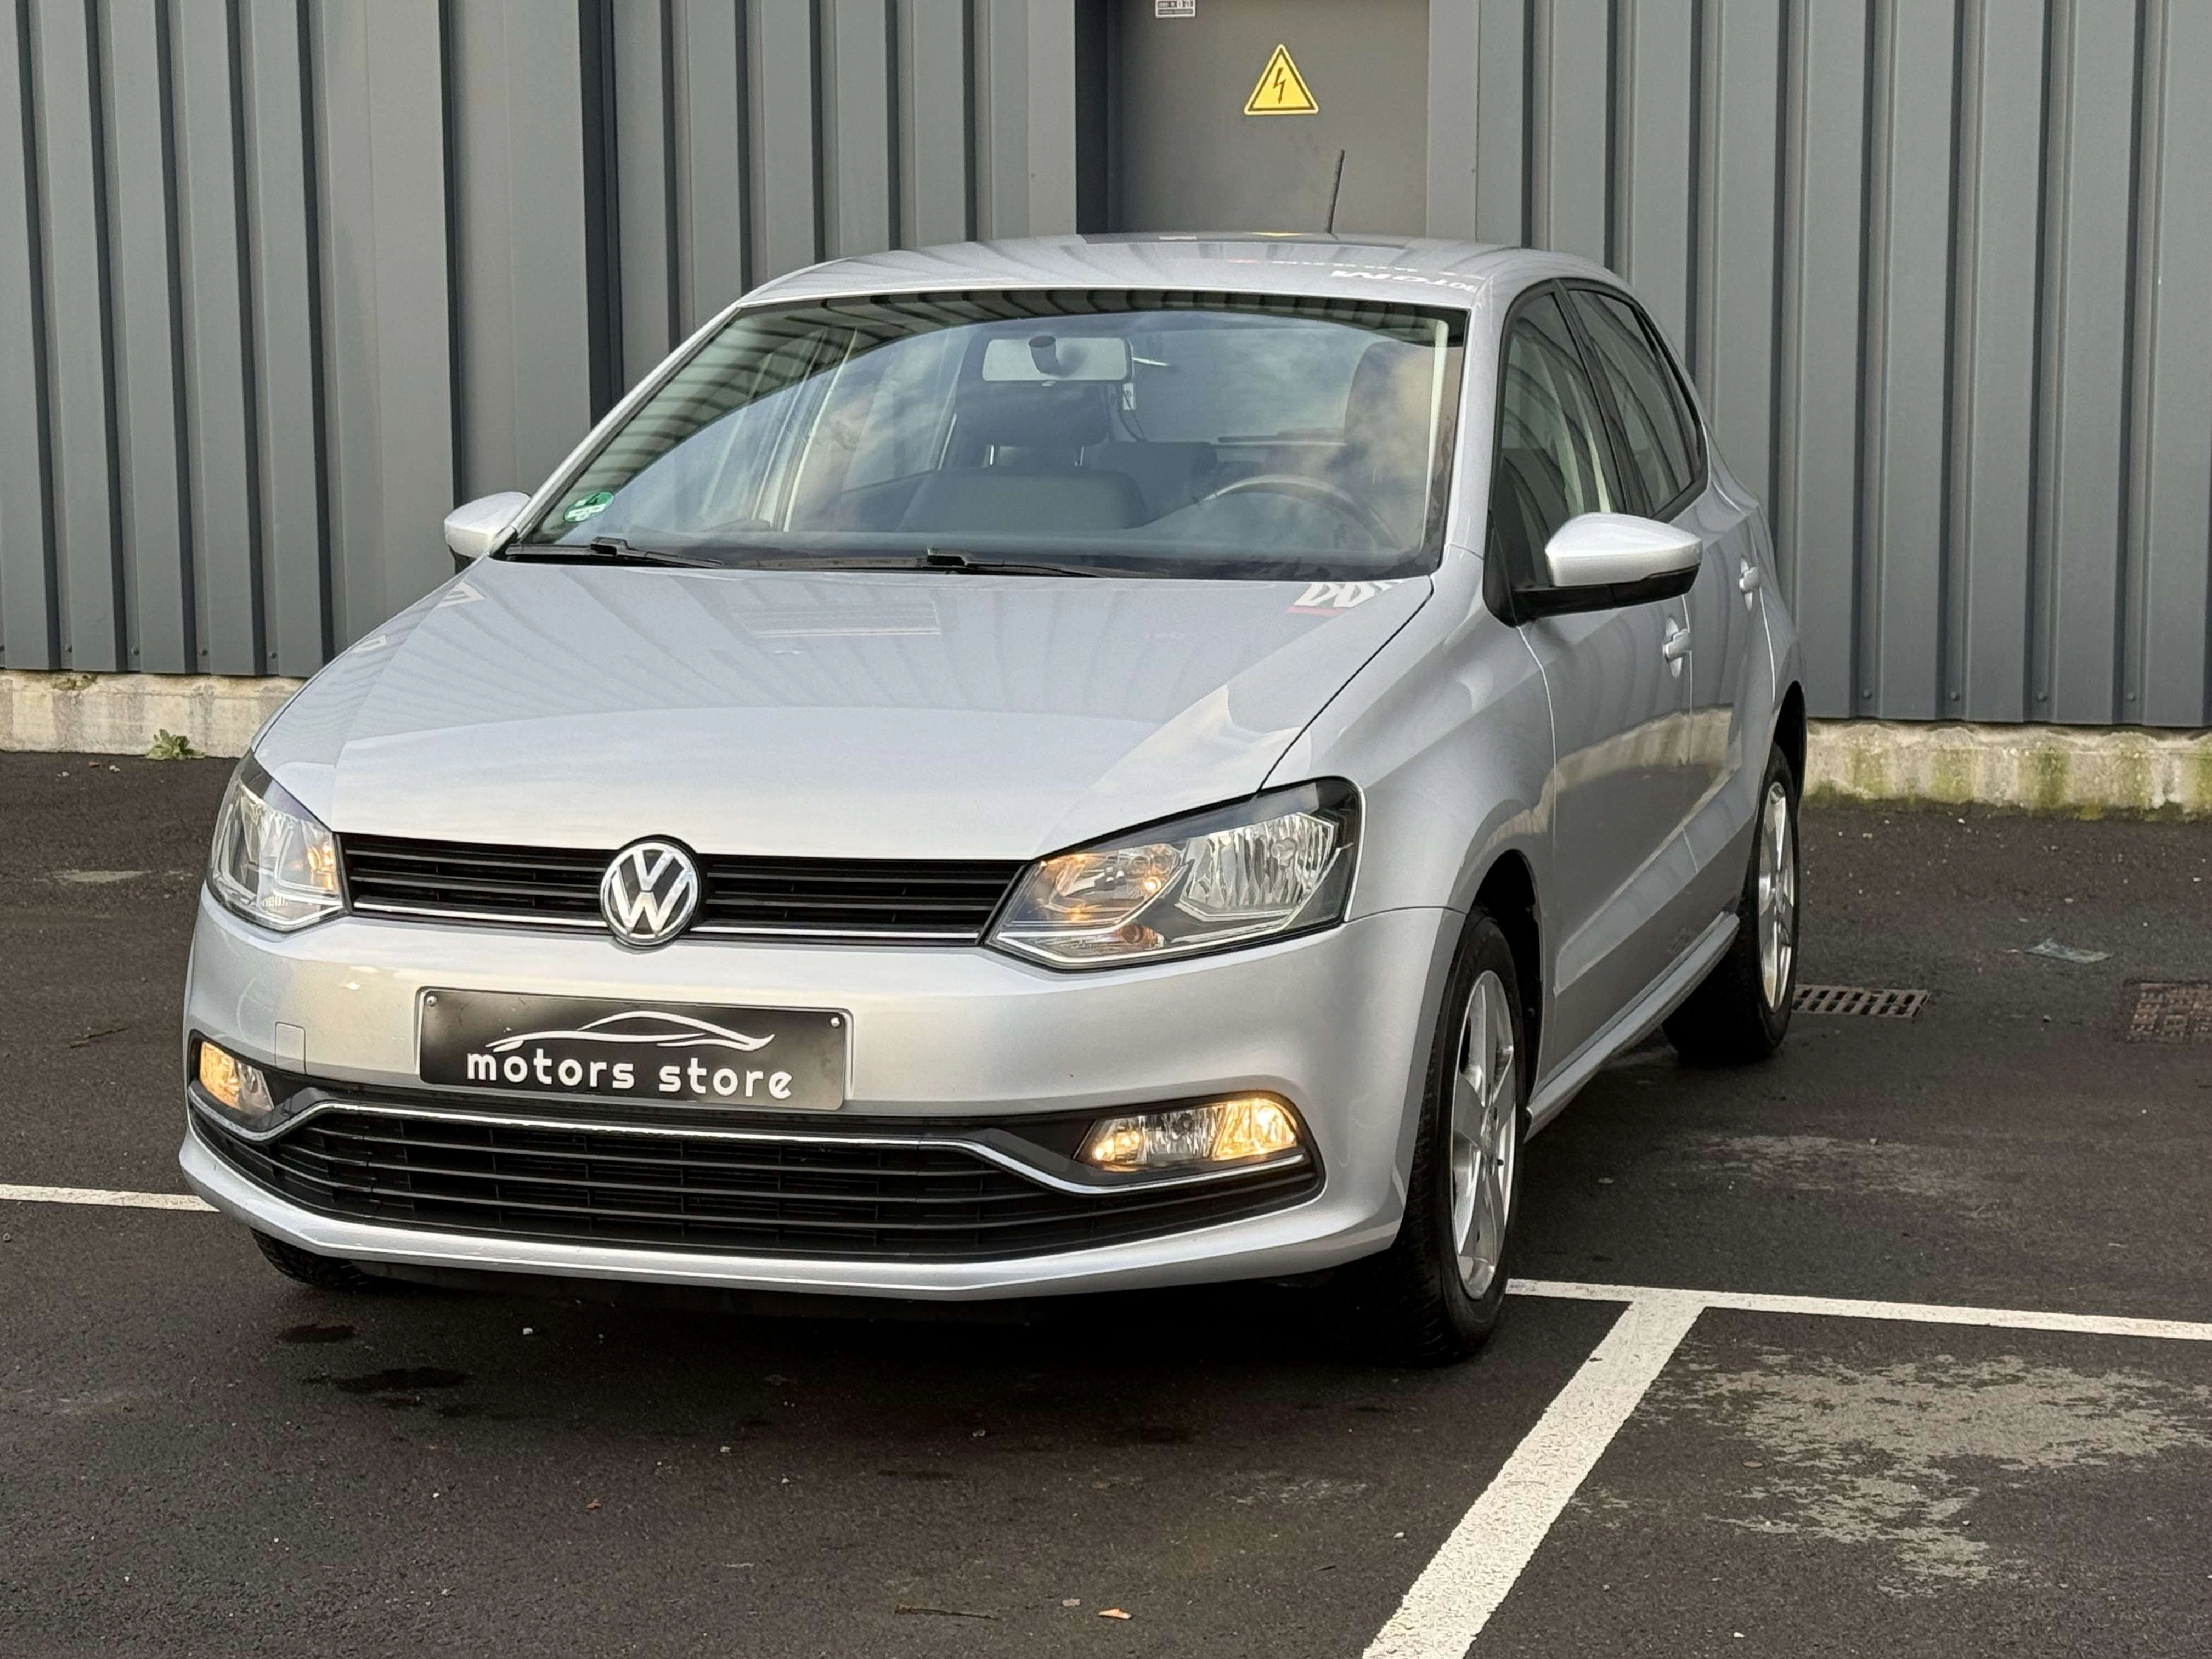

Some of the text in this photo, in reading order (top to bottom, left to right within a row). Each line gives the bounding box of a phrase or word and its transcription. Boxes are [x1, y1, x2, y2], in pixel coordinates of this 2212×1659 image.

[605, 845, 693, 939] VW
[467, 1048, 793, 1099] motors store
